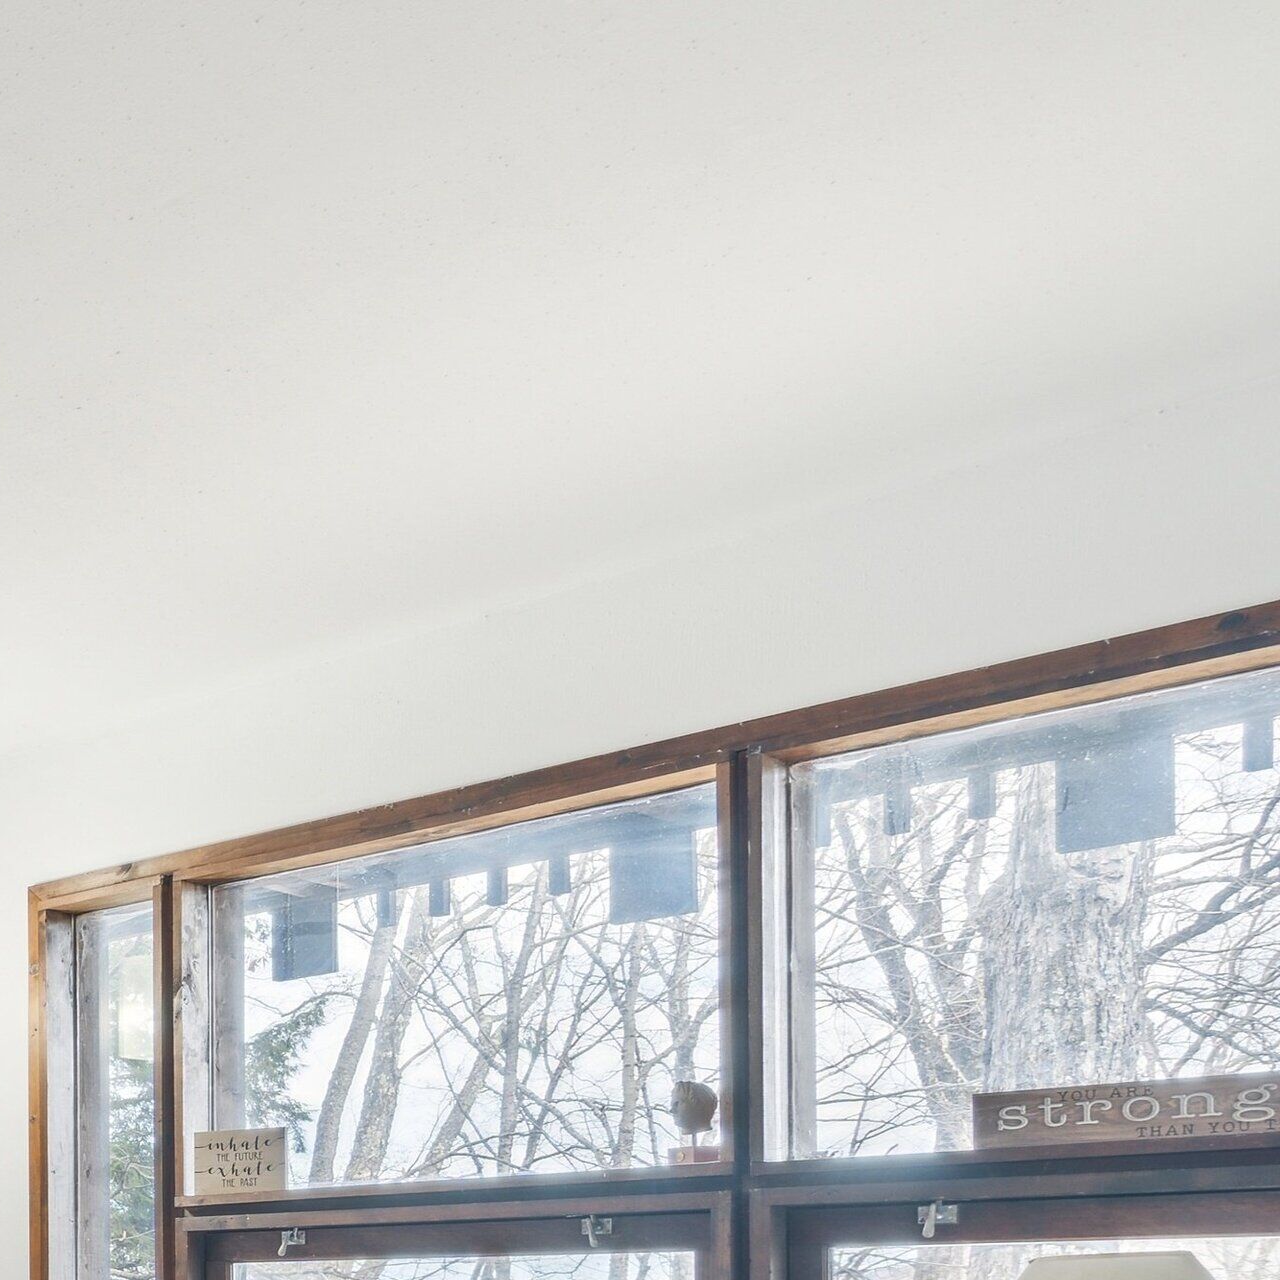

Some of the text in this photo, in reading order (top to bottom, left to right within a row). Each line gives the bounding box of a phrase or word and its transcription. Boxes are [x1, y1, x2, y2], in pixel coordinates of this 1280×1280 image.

[1057, 1085, 1154, 1101] YOU ARE
[997, 1083, 1279, 1132] strong
[1136, 1125, 1194, 1138] THAN
[1208, 1121, 1250, 1133] YOU
[201, 1136, 279, 1152] inhale
[217, 1152, 264, 1162] THE FUTURE
[201, 1162, 279, 1177] exhale
[223, 1178, 257, 1187] THE PAST
